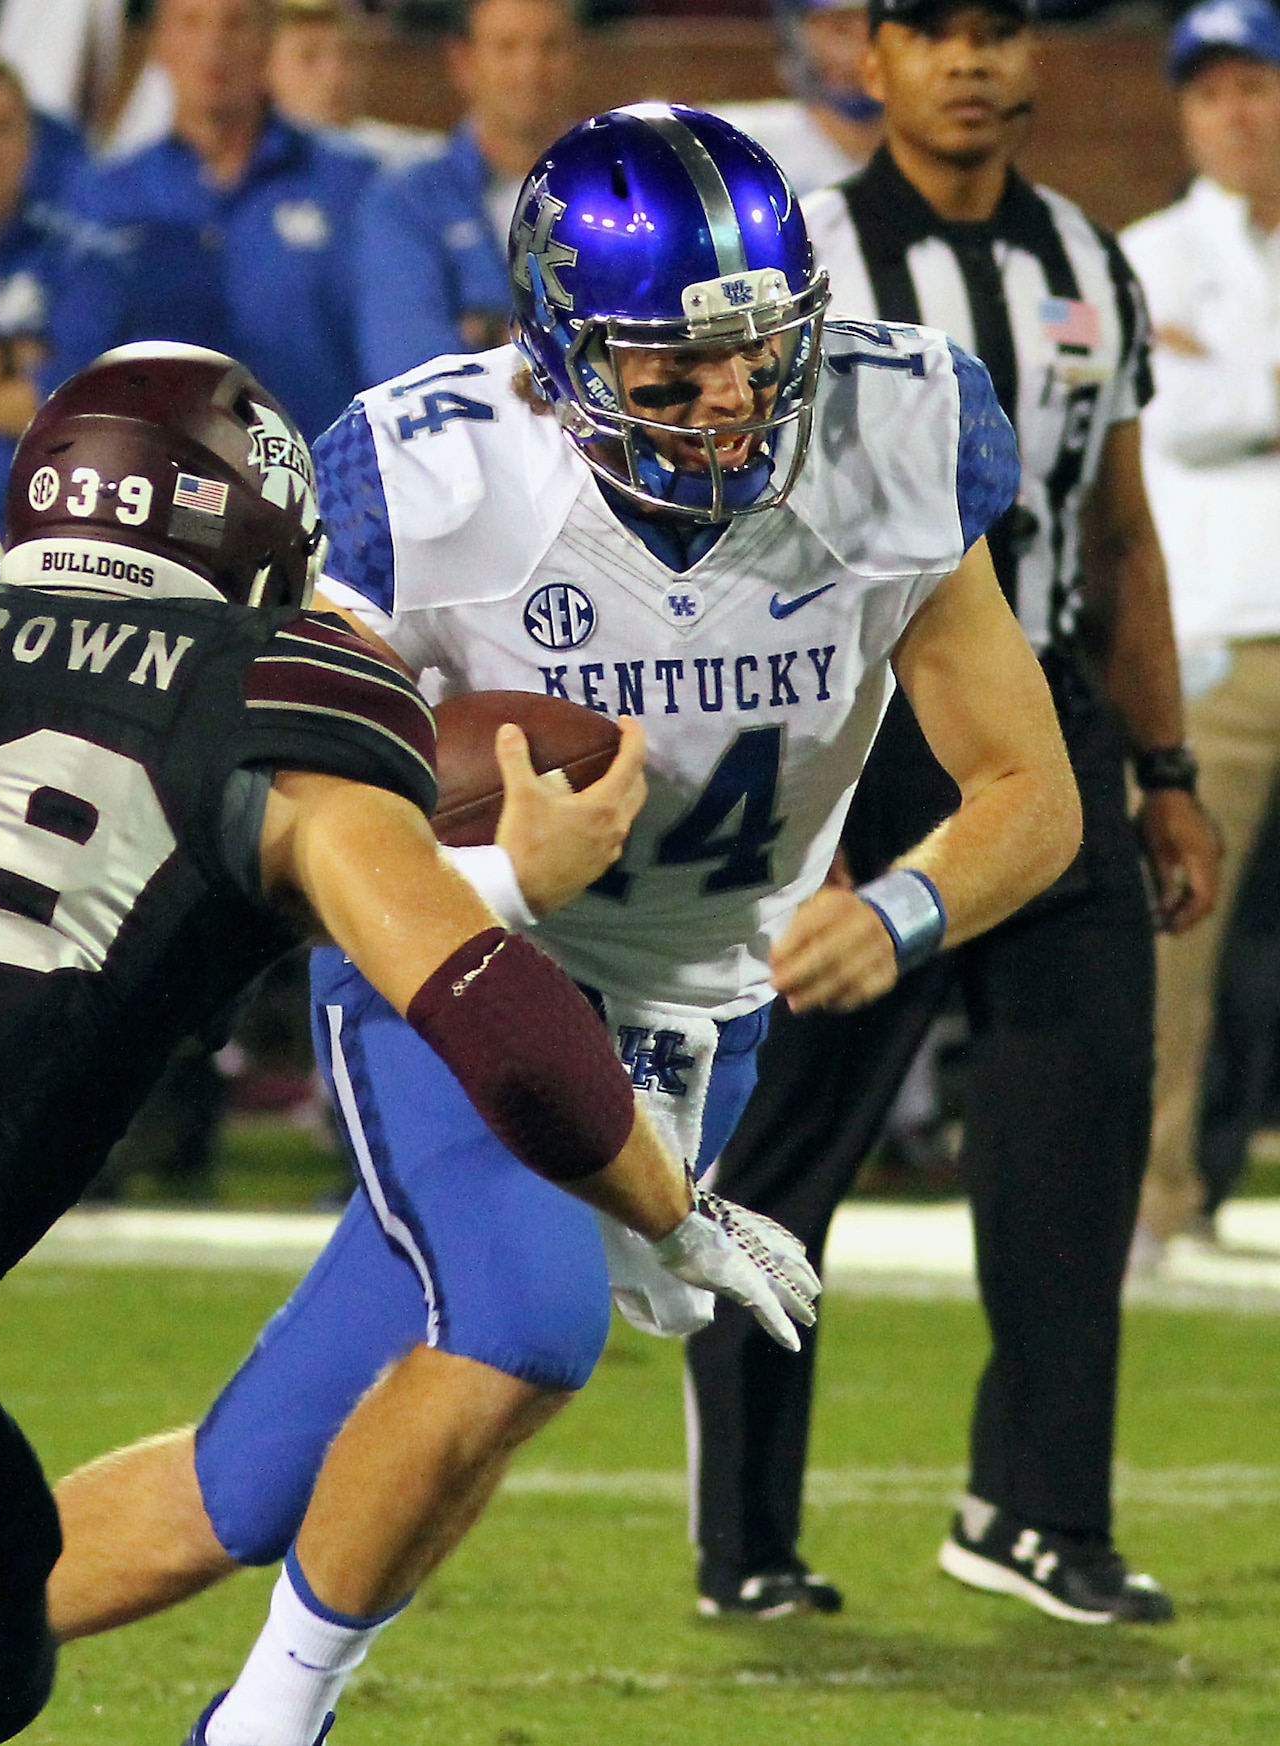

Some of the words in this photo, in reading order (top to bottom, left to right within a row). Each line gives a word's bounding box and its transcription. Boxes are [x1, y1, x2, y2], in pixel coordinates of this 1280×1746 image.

[721, 279, 754, 306] UK
[388, 362, 500, 443] 14
[32, 472, 57, 505] SEC
[66, 466, 153, 526] 39
[41, 551, 155, 588] BULLDOGS
[527, 587, 591, 647] SEC
[667, 594, 696, 617] UK
[538, 644, 837, 716] KENTUCKY
[617, 1024, 696, 1097] UK
